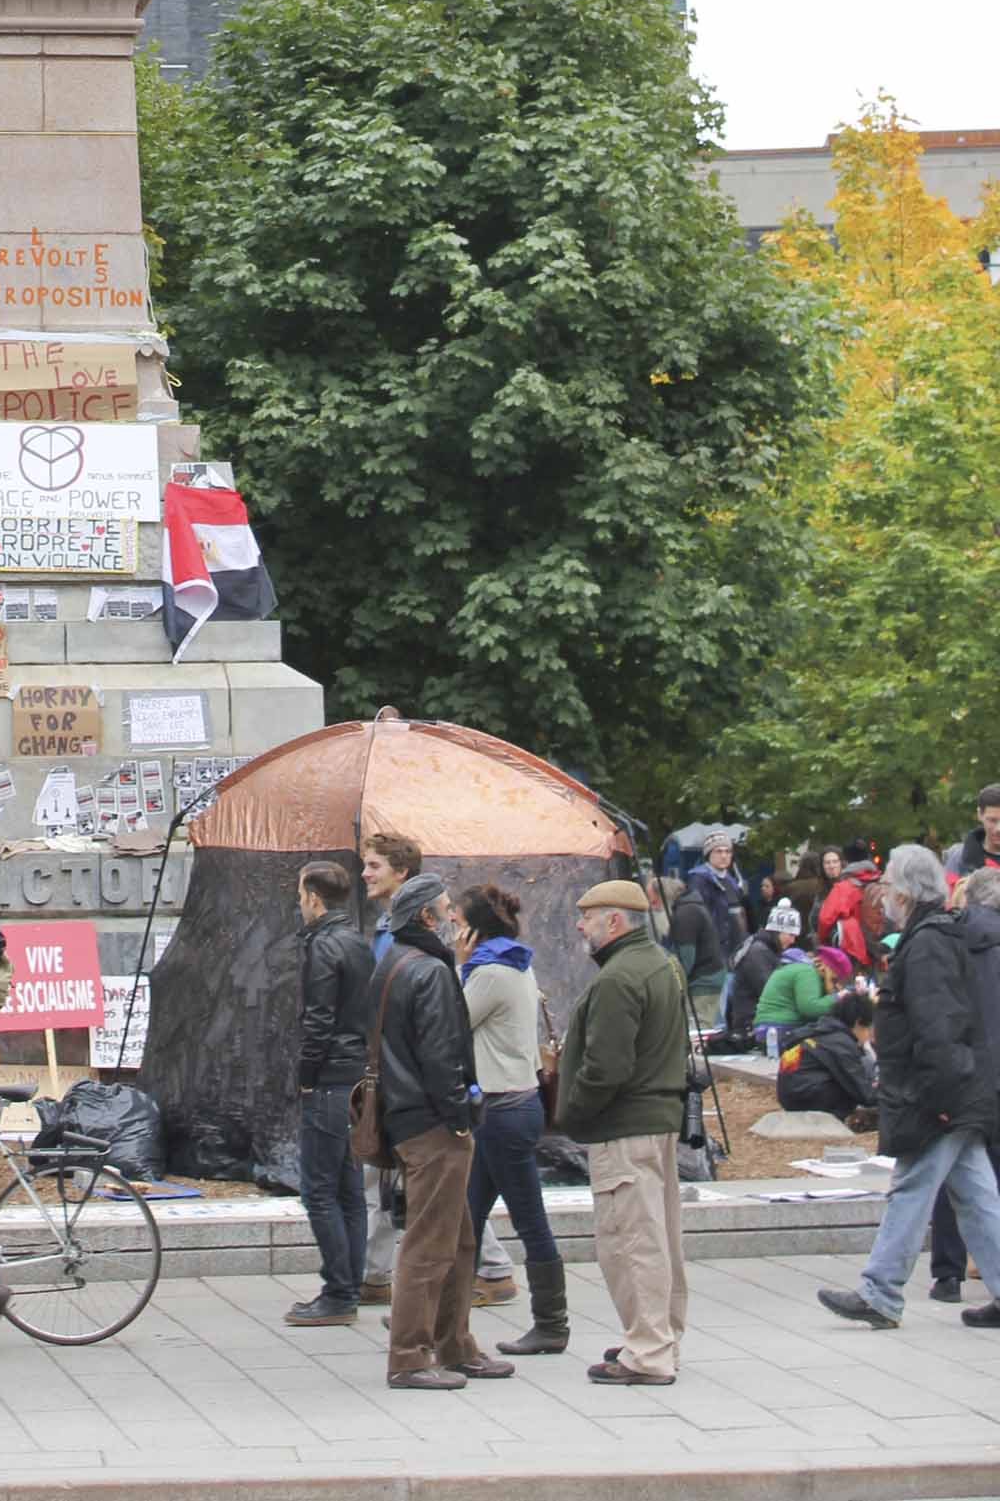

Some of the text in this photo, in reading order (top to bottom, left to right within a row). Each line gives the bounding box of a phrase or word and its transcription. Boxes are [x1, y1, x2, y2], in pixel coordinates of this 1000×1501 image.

[54, 365, 118, 389] LOVE
[4, 389, 132, 420] POLICE
[68, 490, 142, 511] POWER
[20, 686, 91, 708] HORNY
[29, 711, 77, 731] FOR
[25, 946, 64, 973] VIVE
[15, 979, 96, 1013] SOCIALISME
